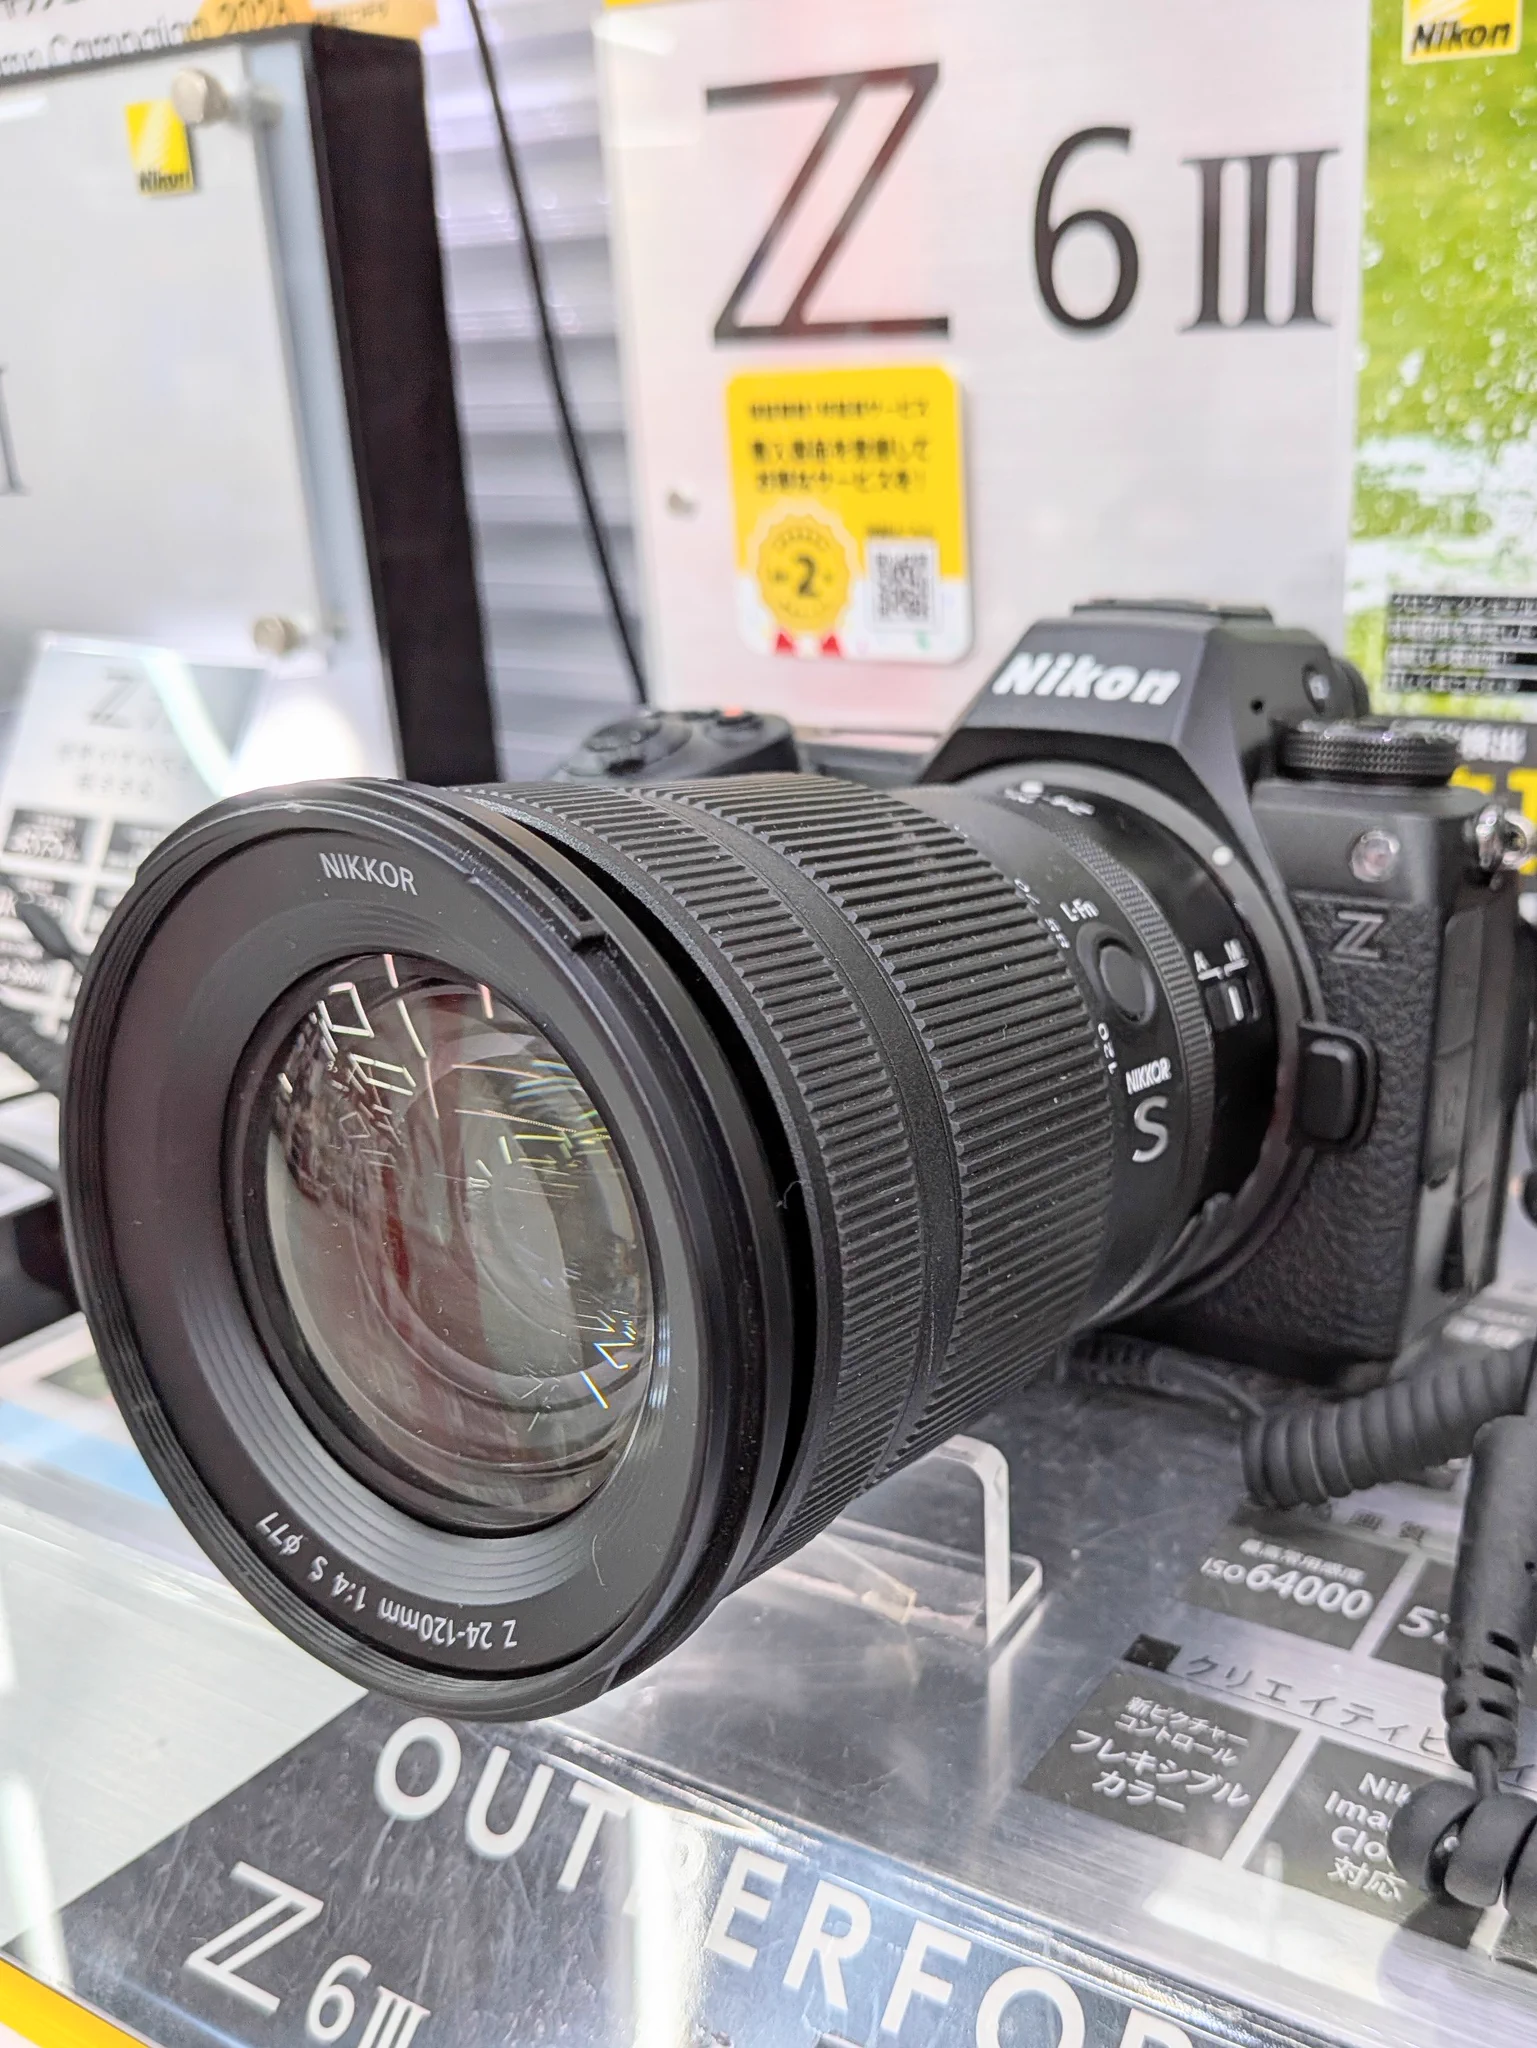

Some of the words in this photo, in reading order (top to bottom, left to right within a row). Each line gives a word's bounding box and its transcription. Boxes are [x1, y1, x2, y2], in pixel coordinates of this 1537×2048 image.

[1410, 20, 1511, 56] Nikon
[704, 60, 950, 345] Z
[795, 552, 817, 598] 2
[992, 651, 1182, 707] Nikon
[319, 852, 418, 896] NIKKOR
[1328, 910, 1384, 963] Z
[1125, 1056, 1172, 1096] NIKKOR
[1131, 1095, 1170, 1164] S
[307, 1555, 329, 1582] S
[330, 1571, 367, 1613] 1:4
[377, 1597, 493, 1650] 24-120mm
[502, 1619, 518, 1649] Z
[1114, 1713, 1239, 1767] コントロール
[1125, 1695, 1250, 1748] 新ピクチャー
[1070, 1729, 1251, 1808] フレキシブル
[1092, 1769, 1187, 1814] カラー
[1324, 1790, 1392, 1832] Ima
[1331, 1825, 1390, 1863] Clo
[1327, 1855, 1409, 1902] 対応
[181, 1860, 324, 2018] Z
